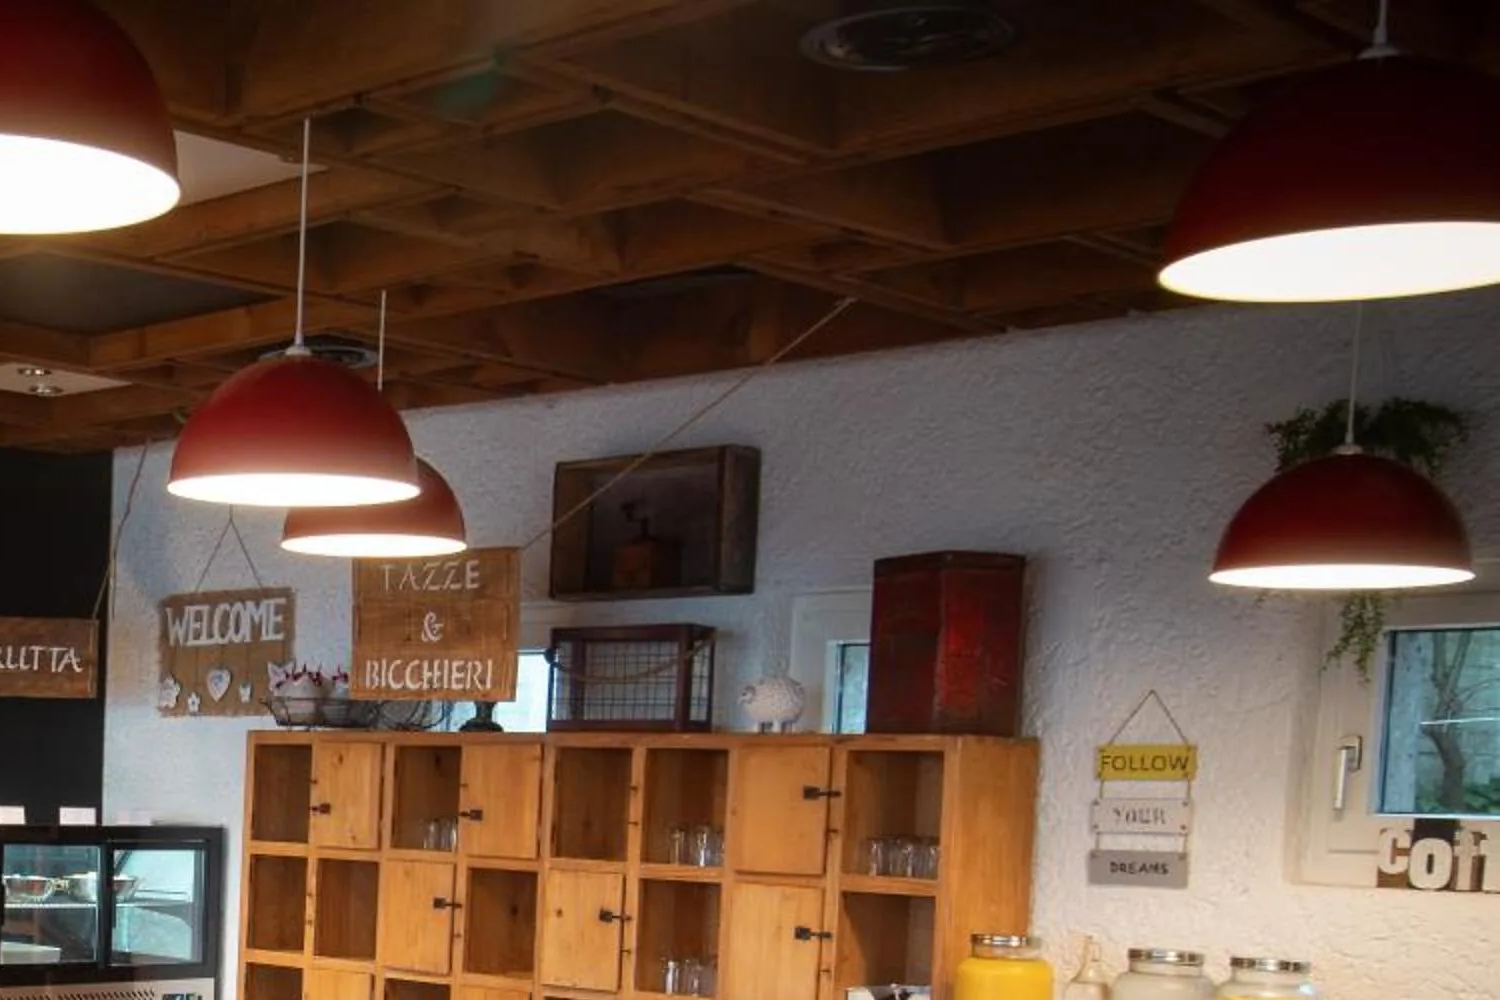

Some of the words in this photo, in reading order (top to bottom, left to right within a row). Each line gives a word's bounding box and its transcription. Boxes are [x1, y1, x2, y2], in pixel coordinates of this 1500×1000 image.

[379, 558, 481, 593] TAZZE
[165, 597, 287, 647] WELCOME
[420, 611, 444, 643] &
[365, 658, 493, 692] BICCHIERI
[1101, 754, 1190, 772] FOLLOW
[1109, 860, 1170, 875] DREAMS
